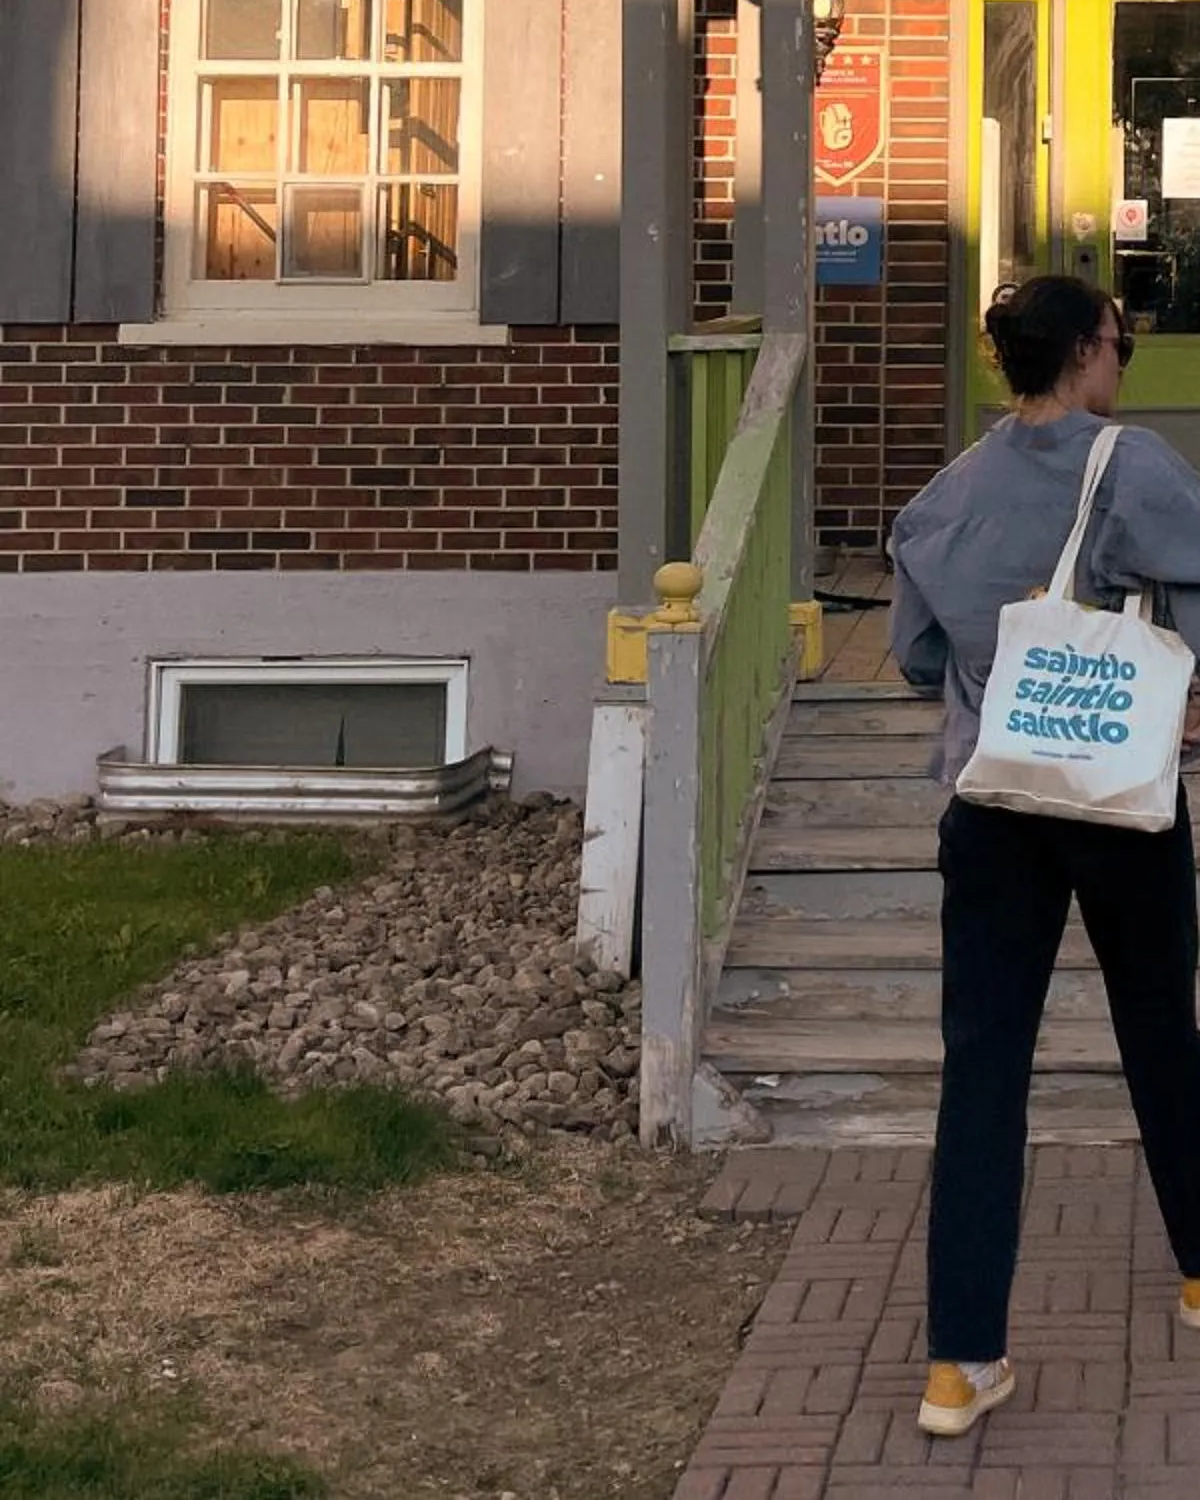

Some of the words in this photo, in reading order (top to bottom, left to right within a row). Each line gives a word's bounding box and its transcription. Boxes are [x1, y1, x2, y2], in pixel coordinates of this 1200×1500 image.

[1024, 643, 1136, 680] saintlo
[1016, 675, 1133, 711] saintlo
[1007, 706, 1129, 744] saintlo
